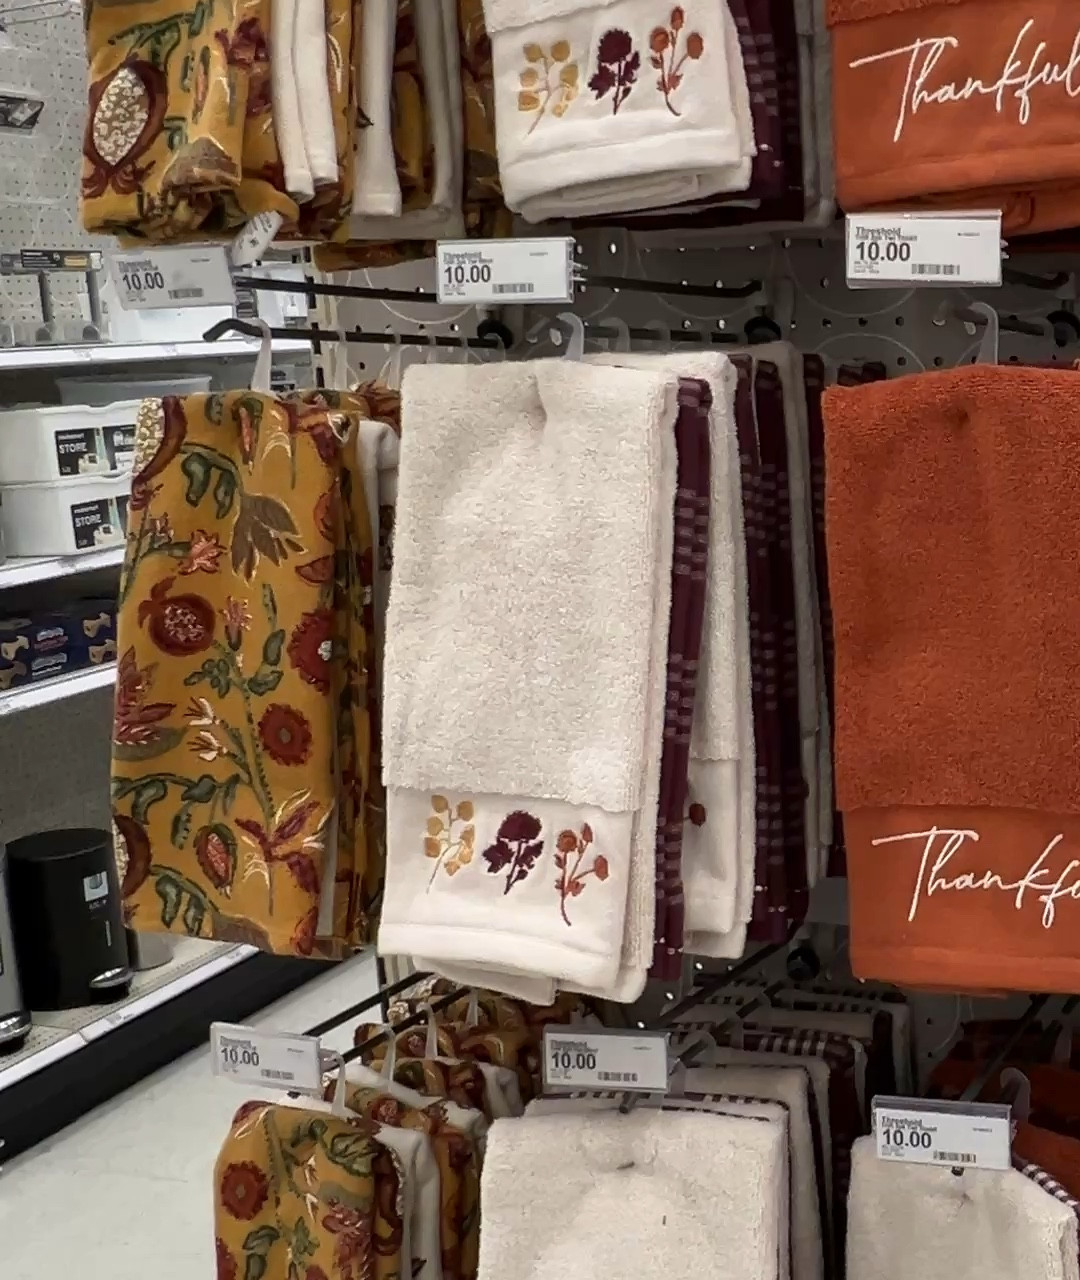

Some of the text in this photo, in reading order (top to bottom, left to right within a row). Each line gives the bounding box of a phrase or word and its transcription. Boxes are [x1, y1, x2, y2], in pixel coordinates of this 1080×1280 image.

[856, 242, 911, 261] 10.00
[123, 271, 164, 291] 10.00
[444, 265, 491, 283] 10.00
[221, 1047, 260, 1066] 10.00
[552, 1051, 596, 1069] 10.00
[883, 1128, 932, 1148] 10.00
